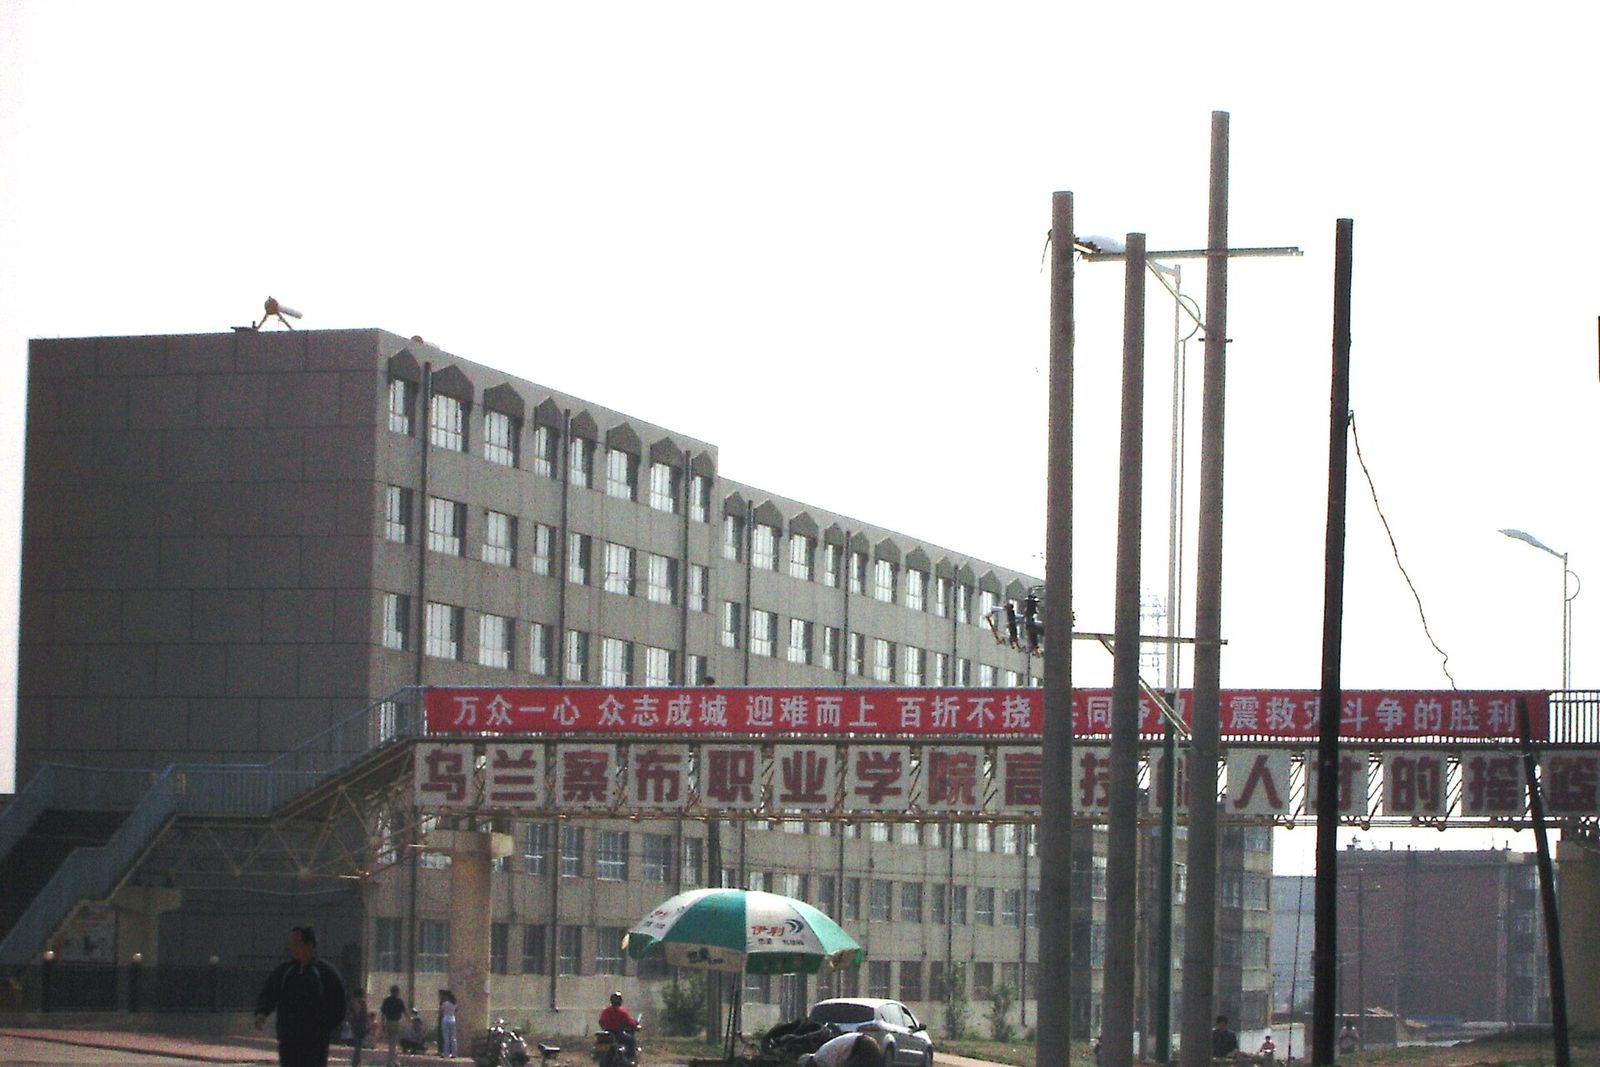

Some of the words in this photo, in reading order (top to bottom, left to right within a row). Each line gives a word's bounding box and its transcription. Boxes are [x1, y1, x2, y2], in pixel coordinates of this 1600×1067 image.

[453, 694, 581, 728] 万众一心
[597, 694, 728, 728] 众志成城
[746, 694, 878, 729] 迎难而上
